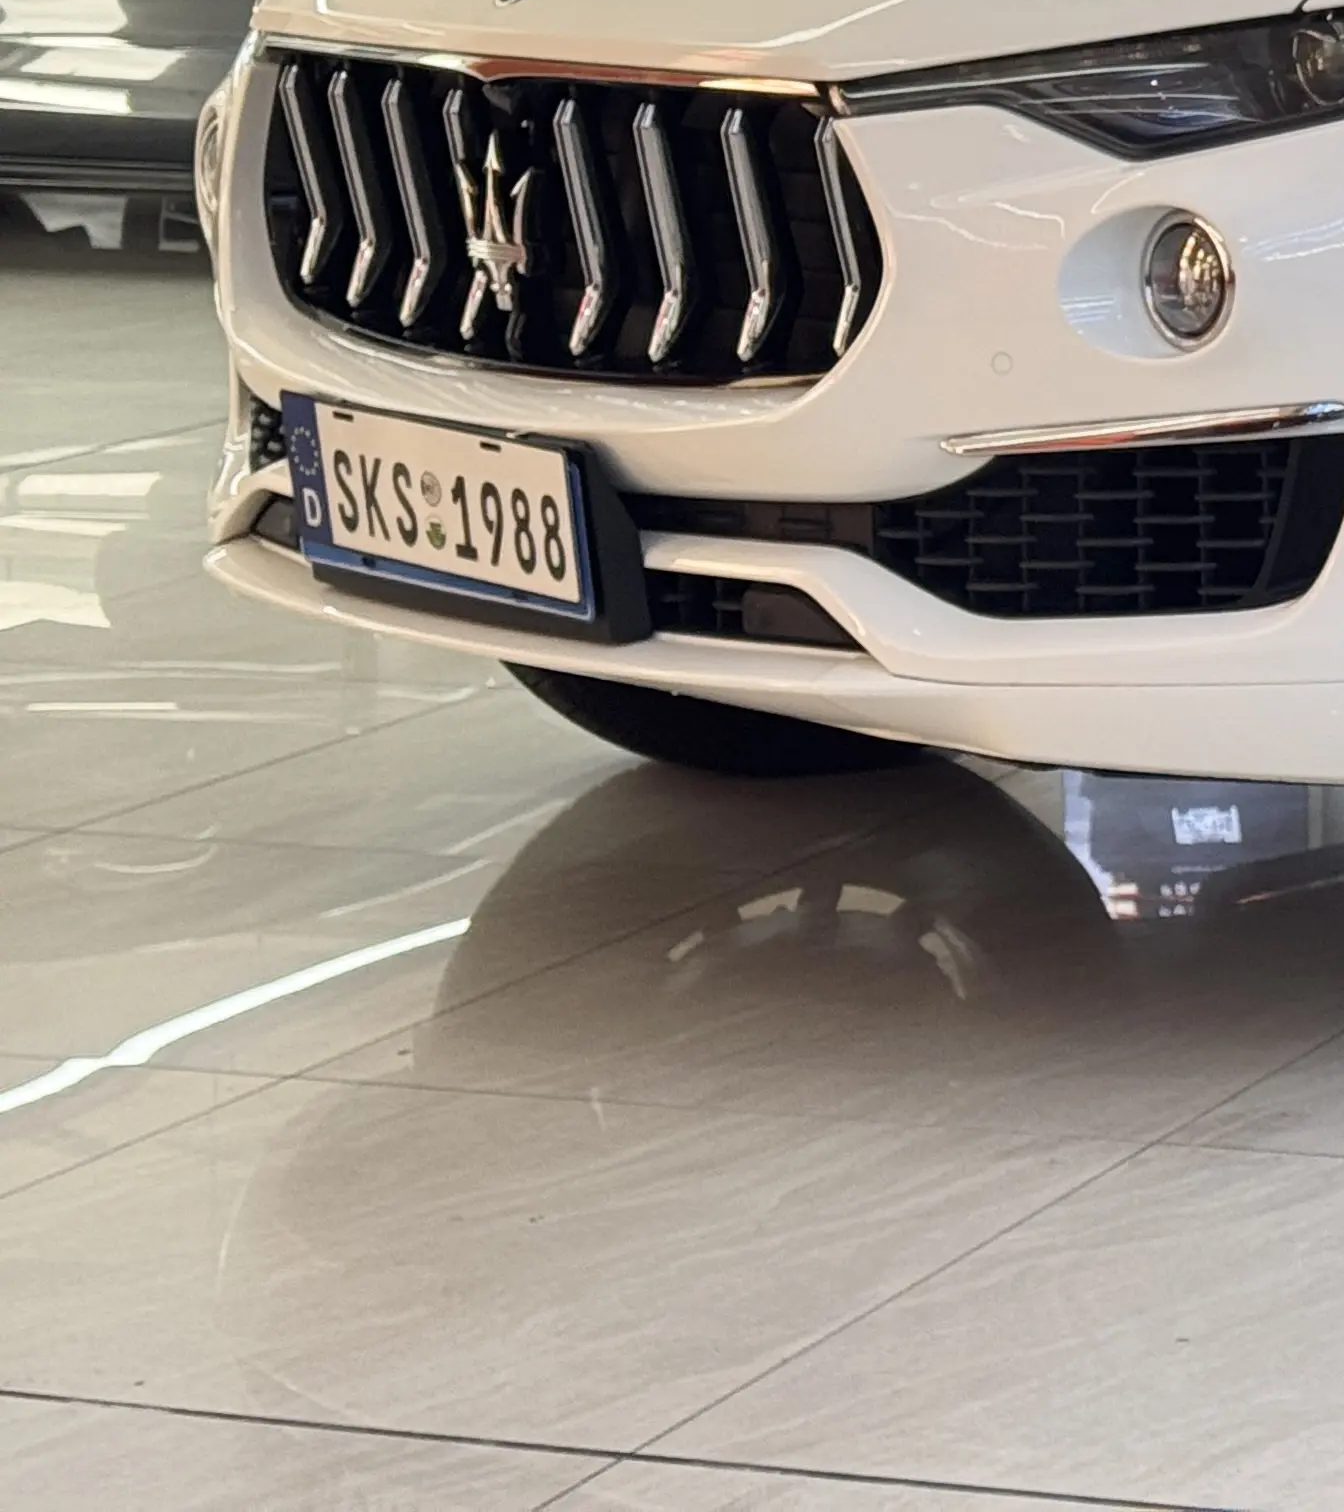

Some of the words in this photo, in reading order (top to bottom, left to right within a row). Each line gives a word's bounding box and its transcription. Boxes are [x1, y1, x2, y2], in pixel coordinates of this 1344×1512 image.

[303, 489, 323, 527] D
[333, 449, 418, 547] SKS
[451, 475, 567, 581] 1988
